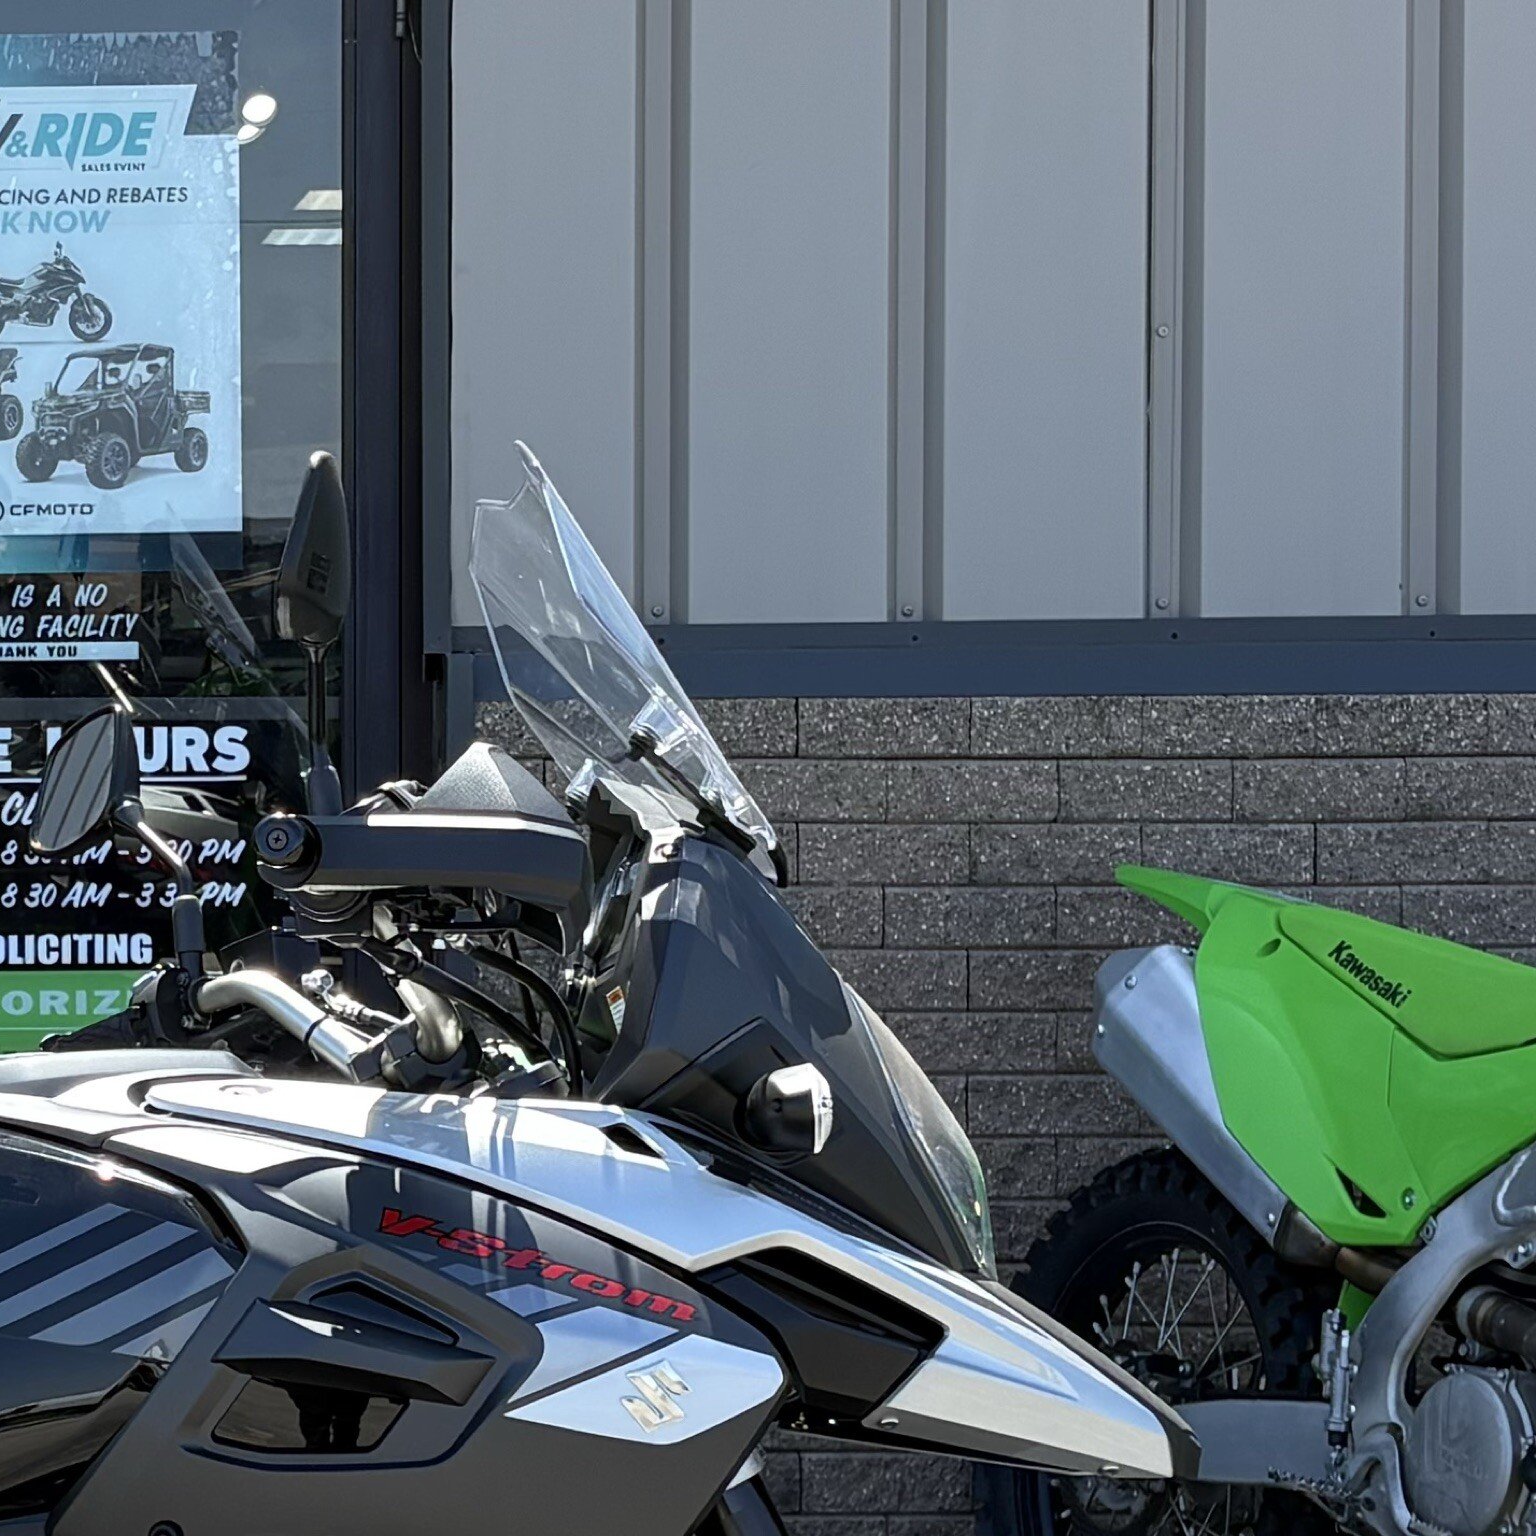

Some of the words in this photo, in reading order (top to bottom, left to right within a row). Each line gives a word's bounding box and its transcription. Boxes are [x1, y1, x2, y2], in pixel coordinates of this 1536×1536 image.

[54, 188, 101, 204] AND
[106, 187, 189, 203] REBATES
[28, 210, 111, 234] NOW
[9, 503, 94, 516] CFMOTO
[11, 584, 35, 608] IS
[46, 584, 61, 608] A
[74, 583, 108, 607] NO
[36, 613, 139, 638] FACILITY
[46, 645, 78, 658] YOU
[46, 725, 251, 773] URS
[198, 838, 247, 864] PM
[60, 882, 113, 908] AM
[198, 882, 247, 907] PM
[1327, 939, 1413, 1009] Kawasaki
[377, 1207, 697, 1321] V-Strom
